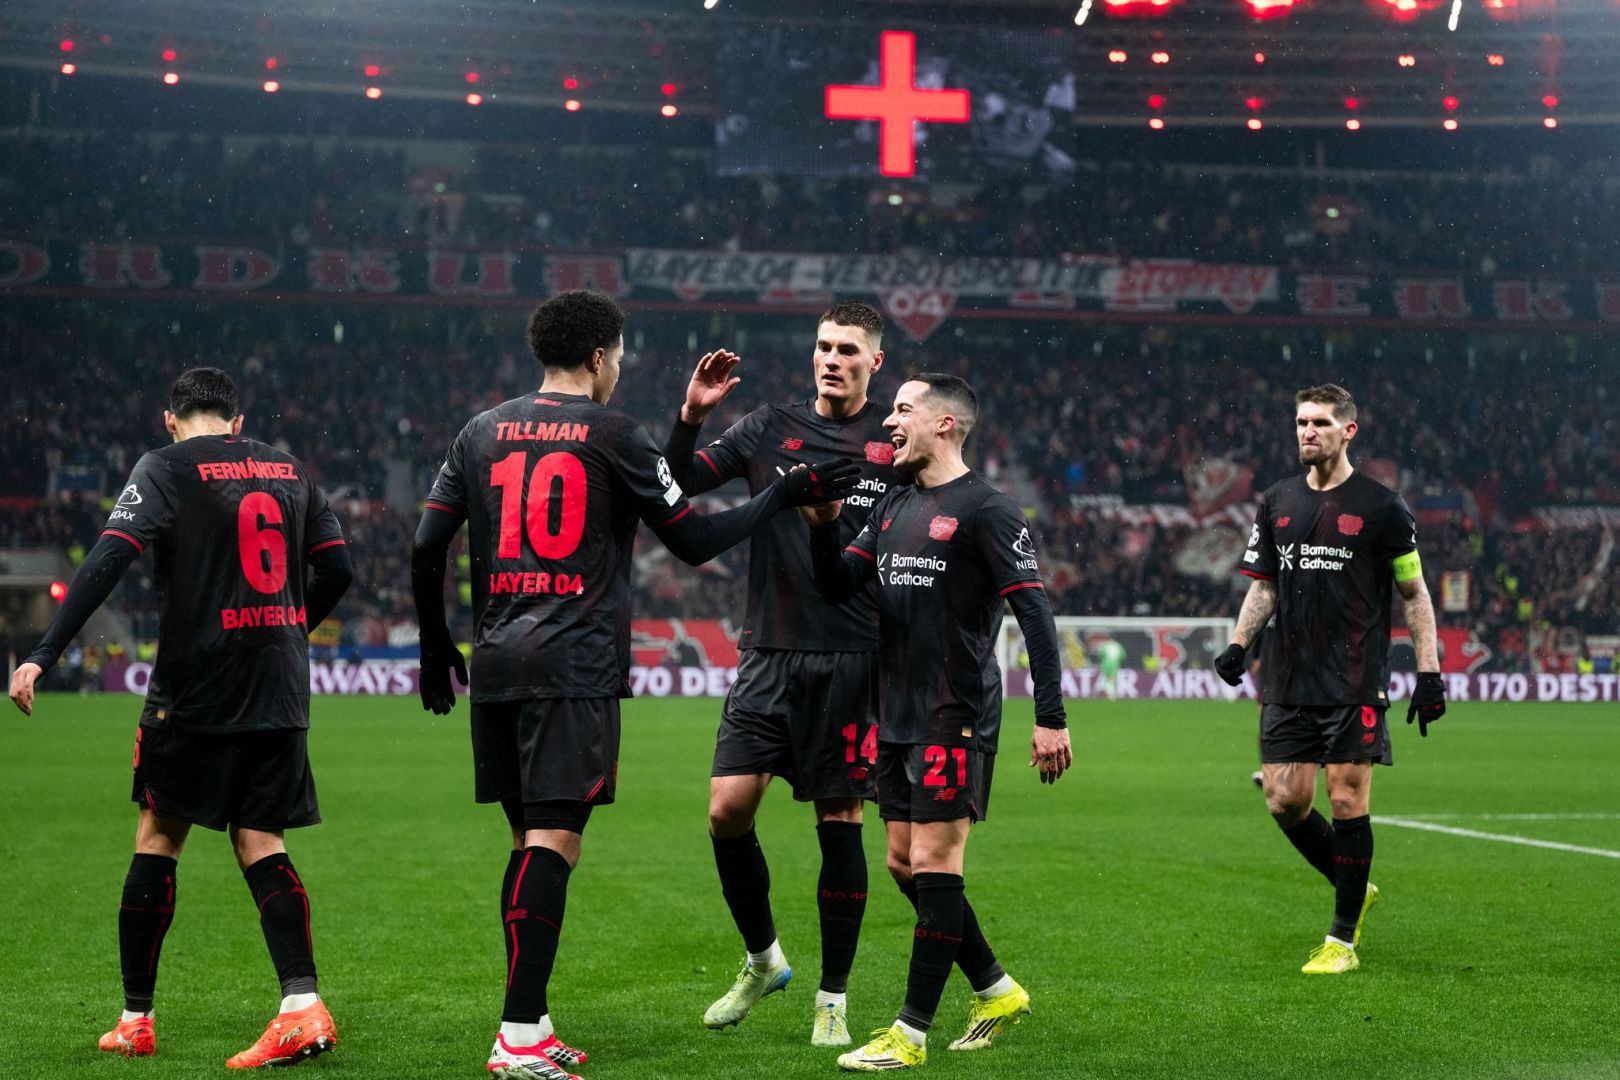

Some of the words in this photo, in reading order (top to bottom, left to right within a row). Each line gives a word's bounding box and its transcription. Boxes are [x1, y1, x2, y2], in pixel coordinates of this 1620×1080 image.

[887, 289, 944, 316] 04
[496, 421, 590, 442] TILLMAN
[197, 457, 299, 481] FERNÁNDEZ
[856, 477, 887, 494] enia
[490, 451, 588, 560] 10
[237, 491, 288, 595] 6
[1300, 543, 1353, 559] Barmenia
[891, 553, 947, 572] Barmenia
[1299, 557, 1344, 571] Gothaer
[554, 573, 585, 595] 04
[889, 571, 935, 588] Gothaer
[221, 605, 286, 630] BAYER
[1478, 672, 1528, 701] 170
[1537, 672, 1620, 701] DEST
[842, 722, 879, 765] 14
[923, 745, 967, 786] 21
